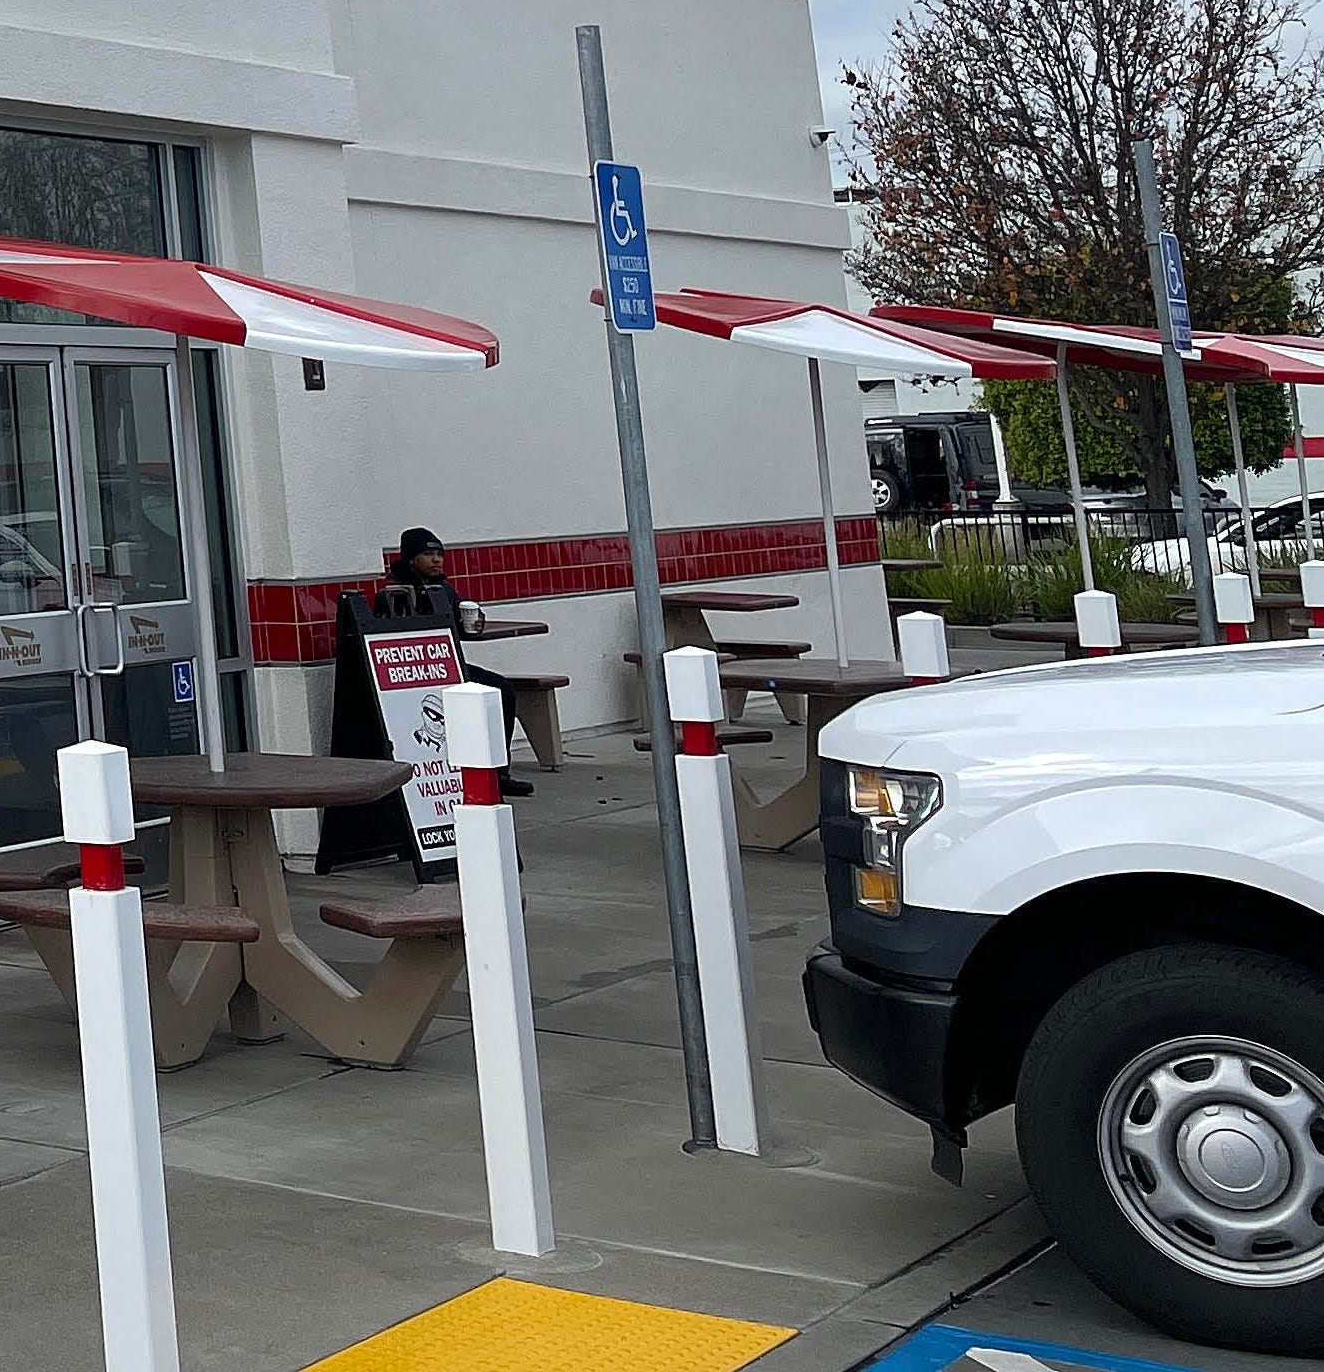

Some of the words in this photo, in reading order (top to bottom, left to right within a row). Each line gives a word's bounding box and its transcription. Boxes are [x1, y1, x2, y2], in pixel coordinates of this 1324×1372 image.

[374, 644, 425, 664] PREVENT
[426, 642, 451, 660] CAR
[387, 662, 448, 683] BREAK-INS
[412, 763, 421, 777] O
[422, 760, 445, 777] NOT
[434, 800, 448, 816] IN
